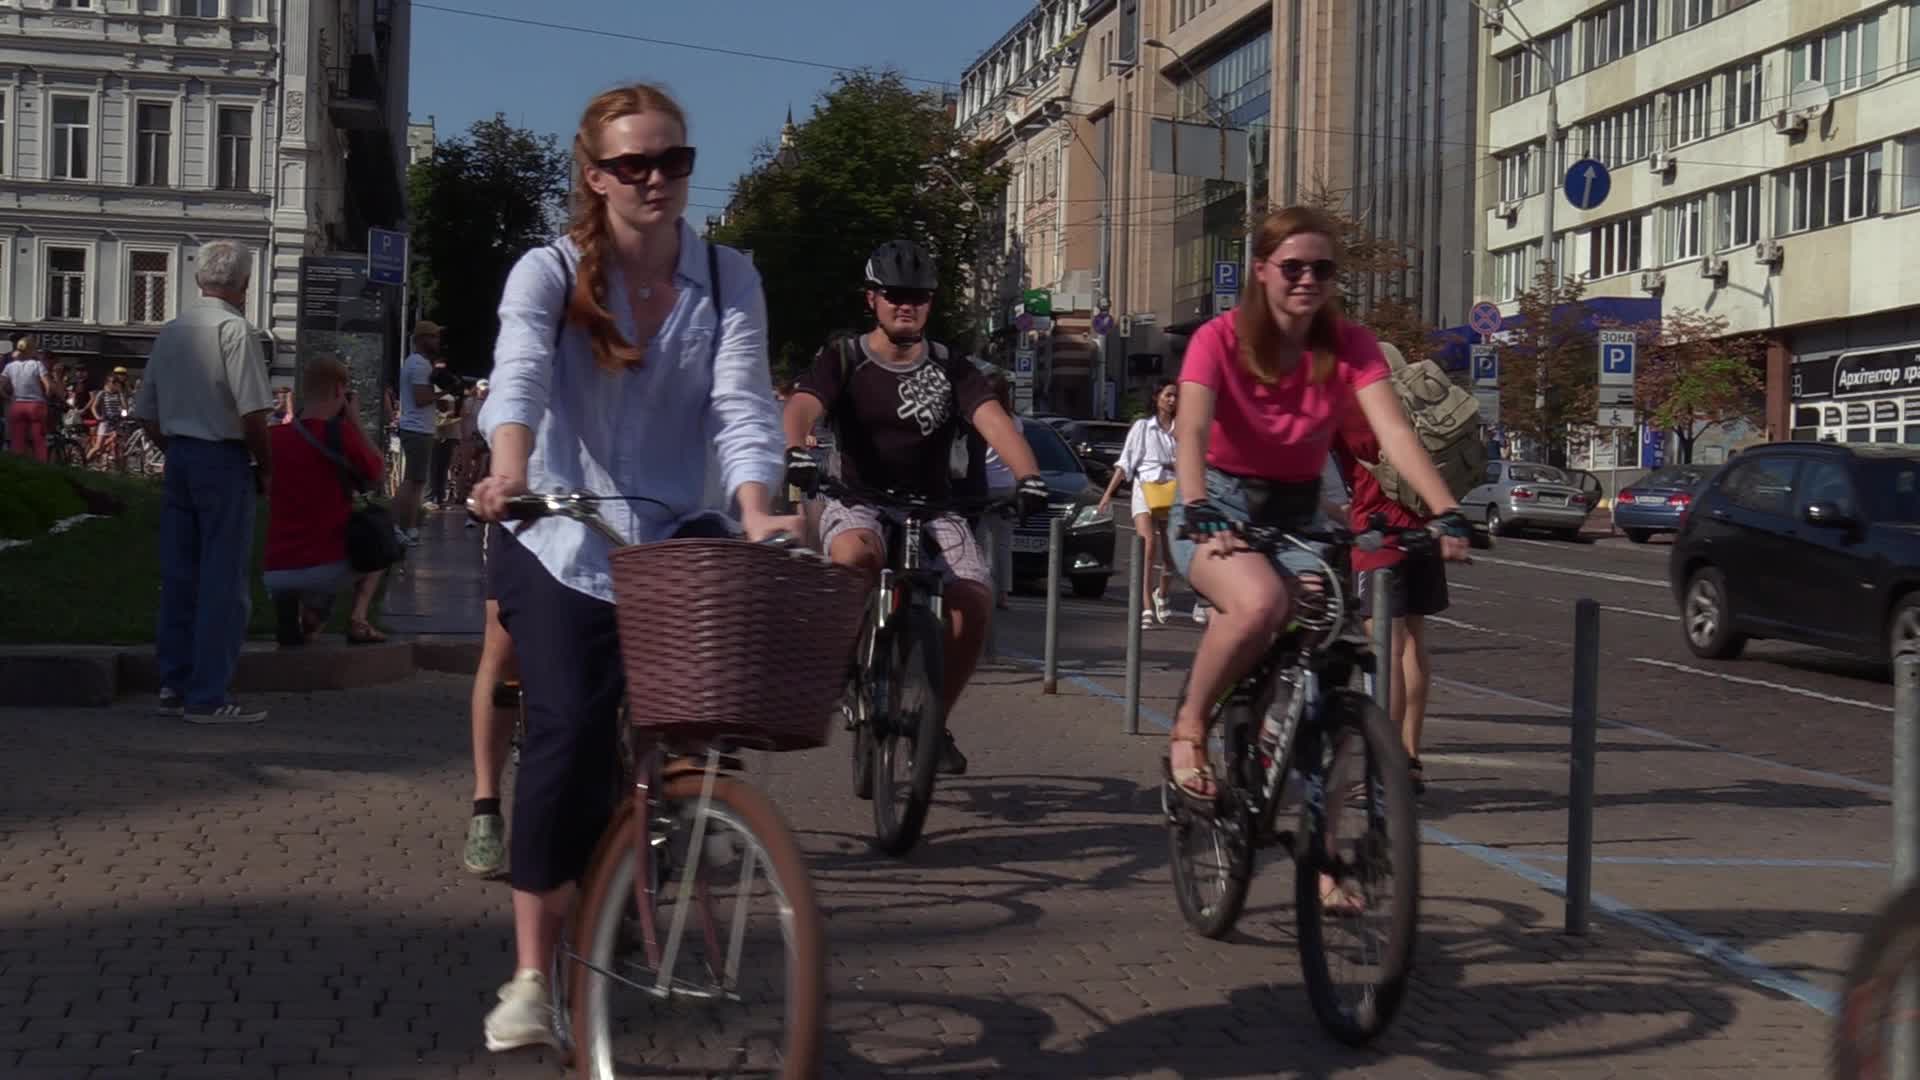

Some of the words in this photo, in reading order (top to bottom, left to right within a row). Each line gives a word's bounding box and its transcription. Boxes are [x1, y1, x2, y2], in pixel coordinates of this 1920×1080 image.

[1219, 264, 1233, 284] P
[1601, 332, 1634, 343] ЗОНА
[1609, 348, 1626, 370] P
[1838, 367, 1901, 391] Архітектор
